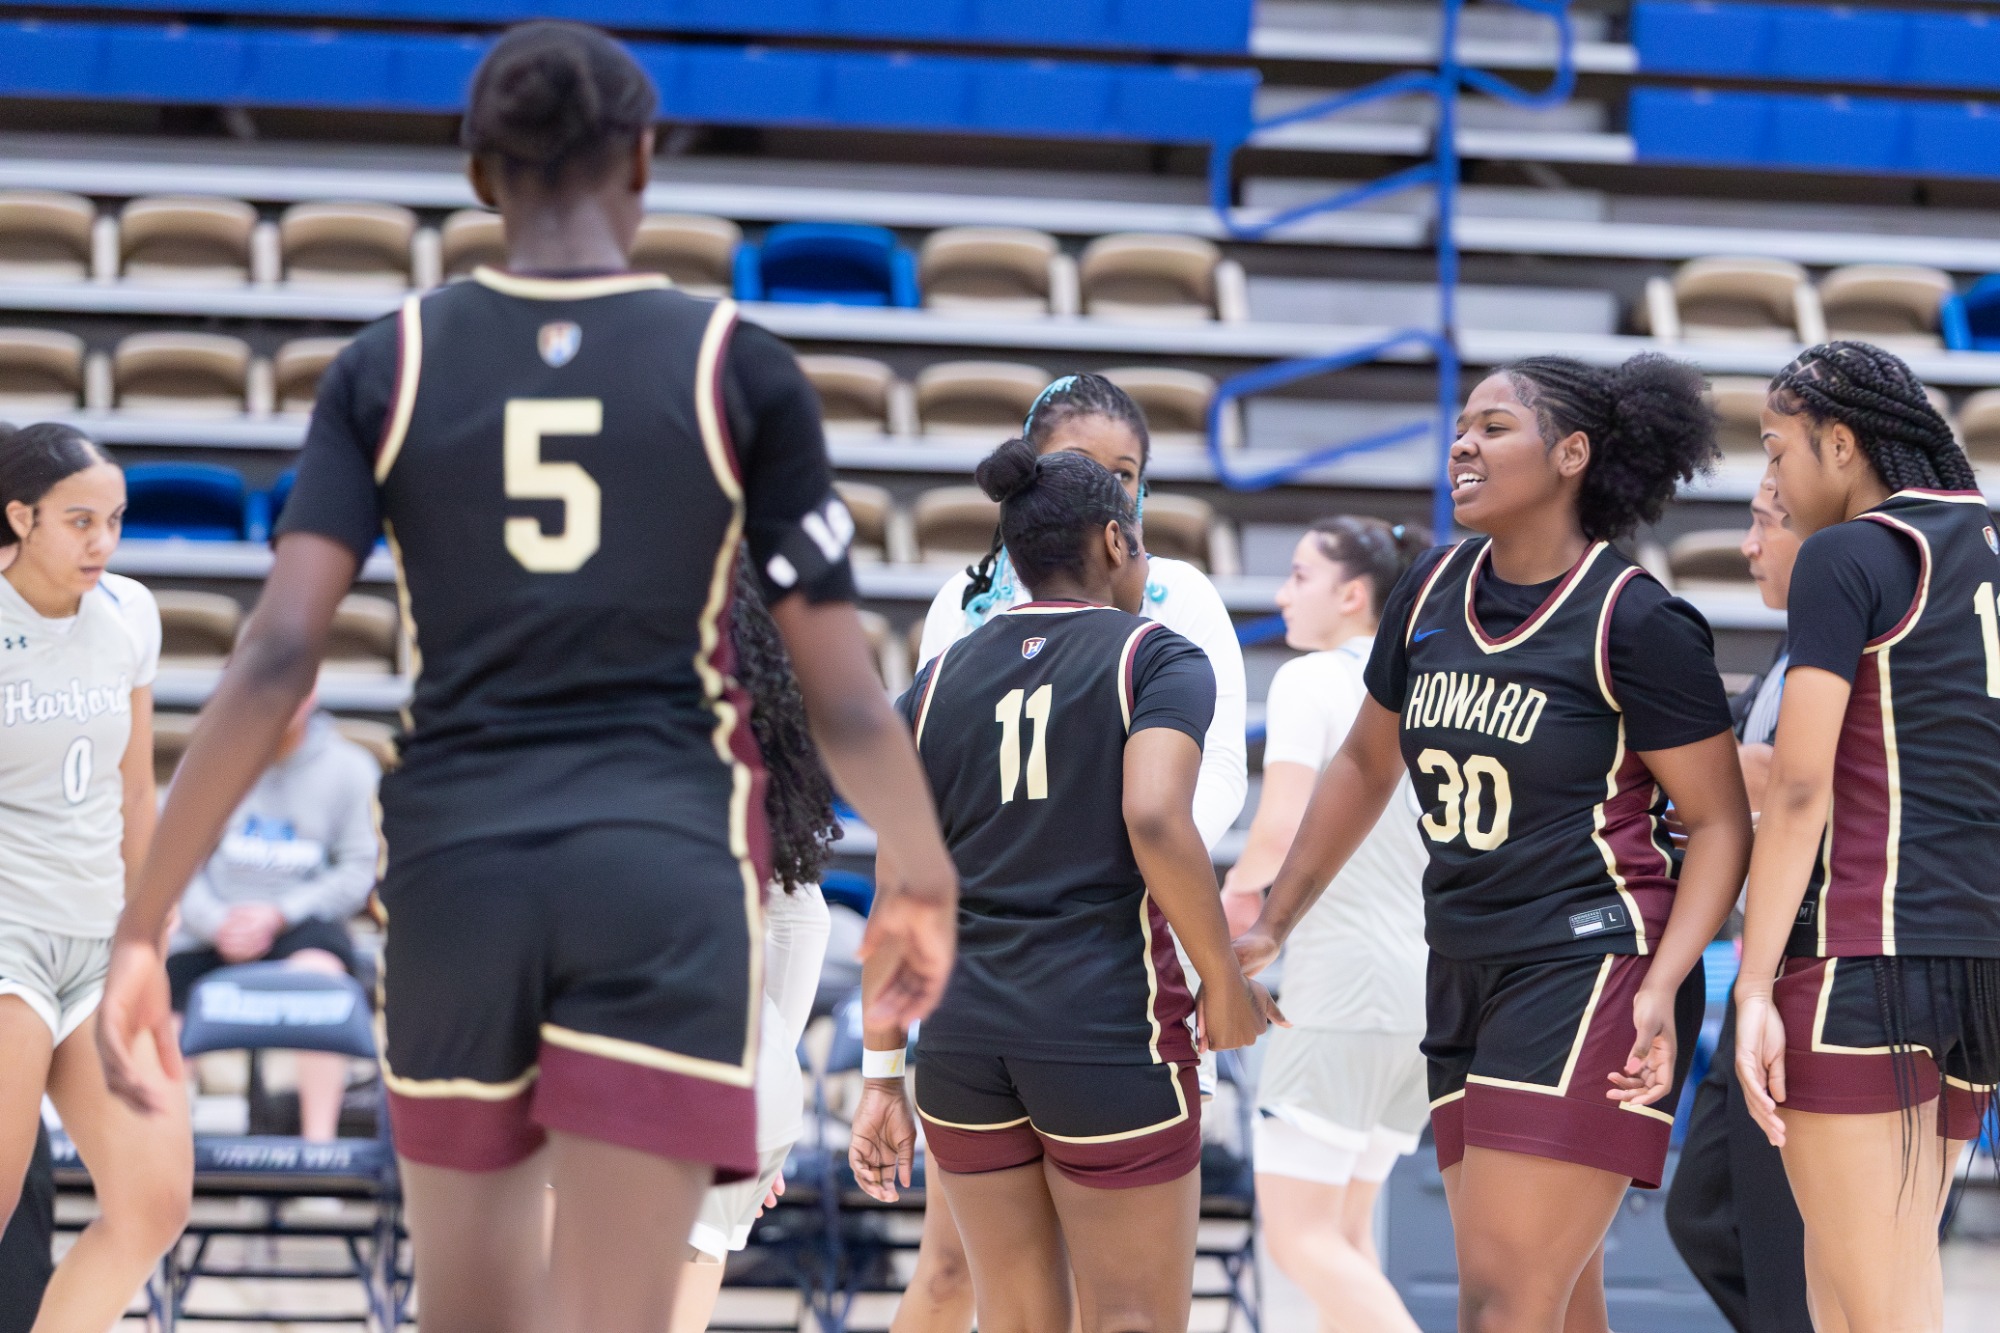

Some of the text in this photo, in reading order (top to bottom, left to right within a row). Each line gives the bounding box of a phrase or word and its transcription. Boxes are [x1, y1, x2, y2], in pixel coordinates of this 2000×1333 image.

[505, 398, 602, 574] 5
[1974, 581, 2000, 698] 1
[4, 672, 128, 727] Harford
[1405, 671, 1548, 744] HOWARD
[62, 735, 93, 805] 0
[995, 684, 1052, 804] 11
[1417, 747, 1512, 851] 30
[1608, 912, 1617, 922] L
